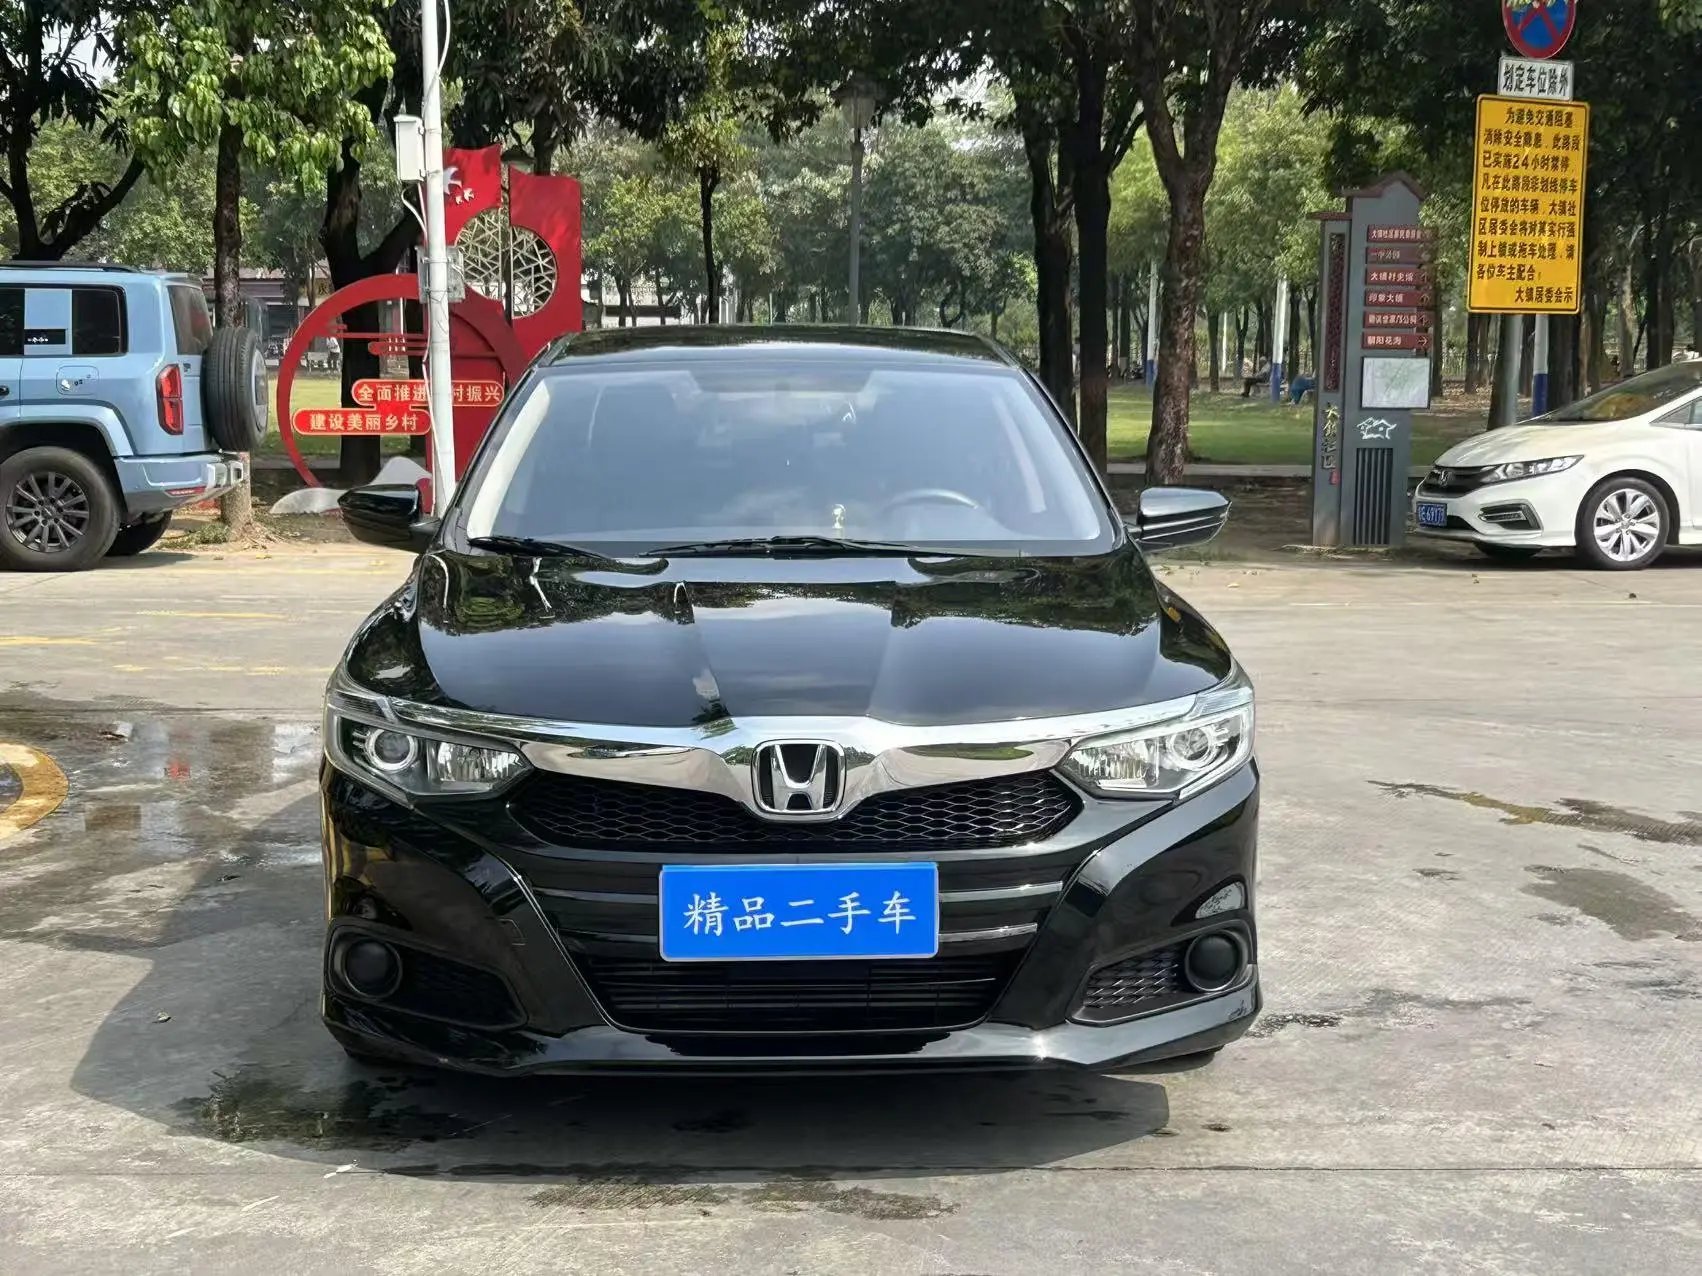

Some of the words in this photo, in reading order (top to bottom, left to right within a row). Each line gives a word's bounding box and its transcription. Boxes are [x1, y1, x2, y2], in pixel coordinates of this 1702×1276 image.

[357, 383, 501, 402] 全面推进村振兴
[309, 413, 419, 431] 建设美丽乡村
[683, 890, 917, 937] 精品二手车
